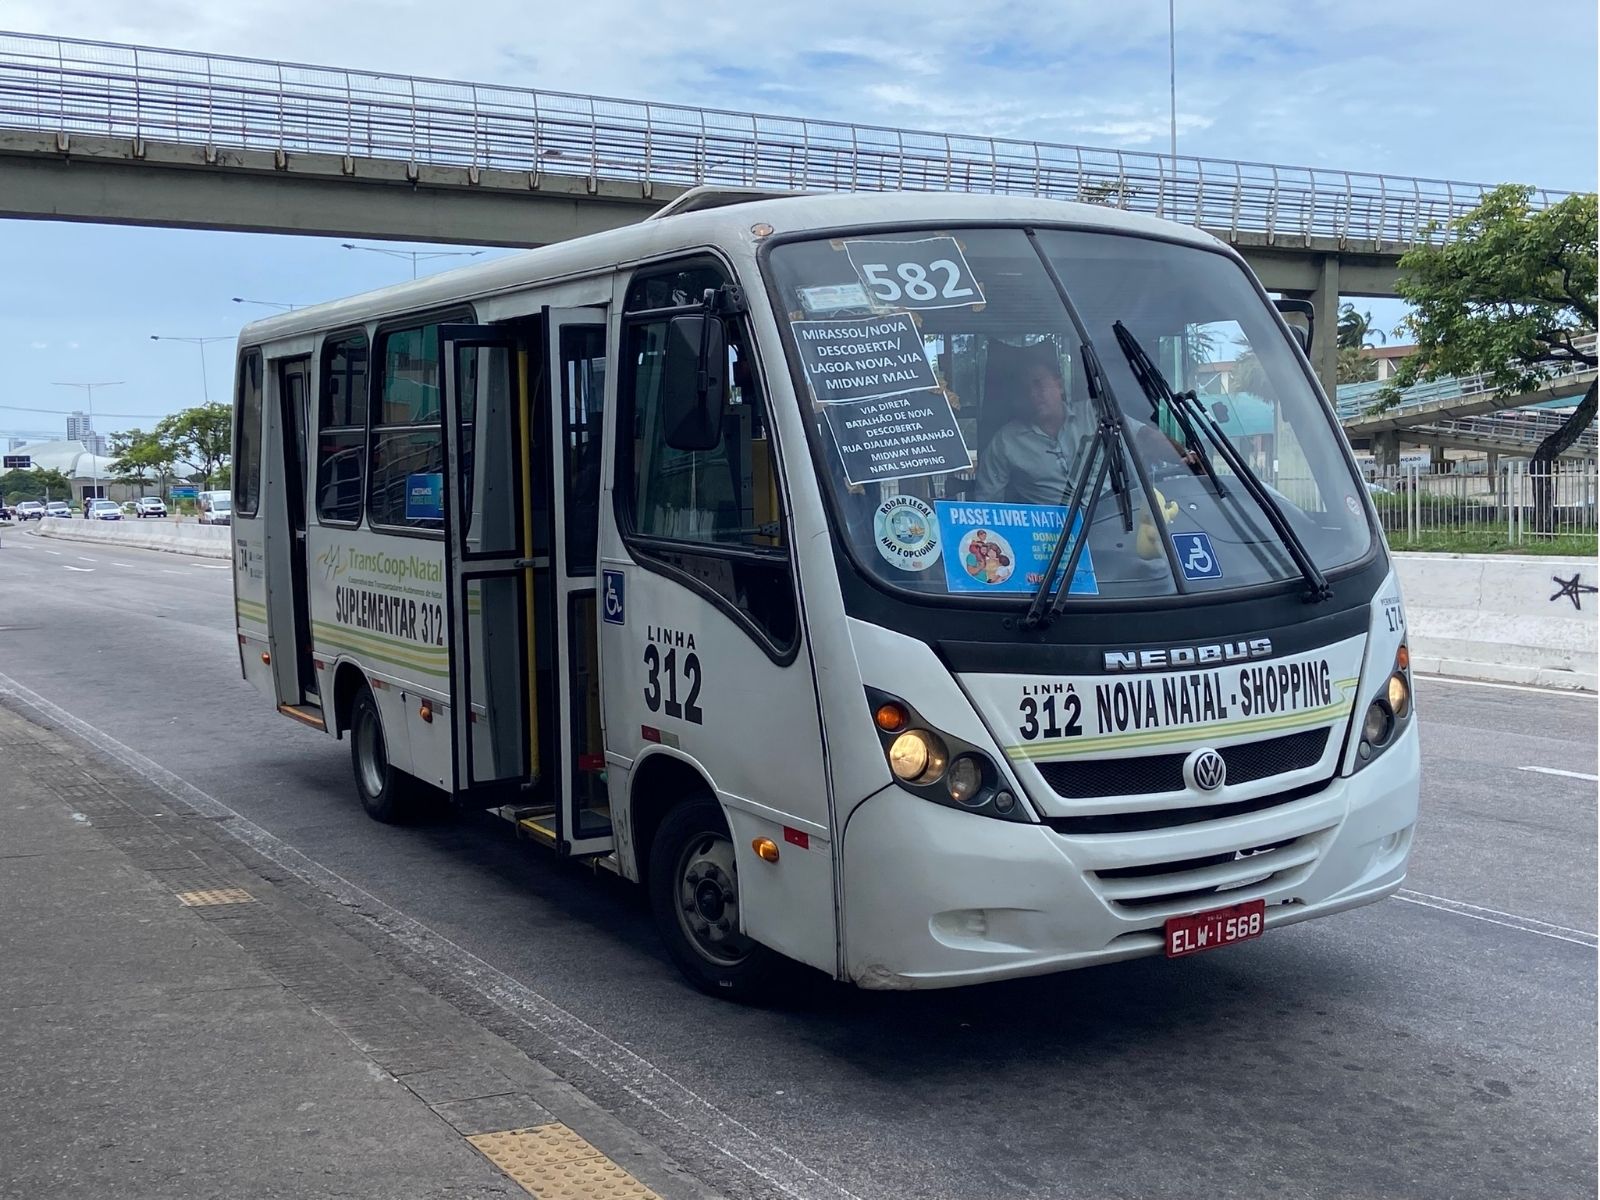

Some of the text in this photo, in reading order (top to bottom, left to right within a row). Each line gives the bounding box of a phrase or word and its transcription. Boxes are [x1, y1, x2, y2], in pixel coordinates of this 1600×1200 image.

[862, 259, 974, 301] 582
[802, 321, 908, 340] MIRASSOL/NOVA
[817, 337, 901, 357] DESCOBERTA/
[810, 352, 922, 374] LAGOA NOVA, VIA
[825, 369, 919, 390] MIDWAY MALL
[860, 398, 911, 415] VIA DIRETA
[845, 408, 934, 429] BATALHÃO DE NOVA
[866, 422, 923, 438] DESCOBERTA
[842, 429, 955, 453] RUA DJALMA MARANHÃO
[870, 444, 936, 462] MIDWAY MALL
[869, 456, 946, 474] NATAL SHOPPING
[880, 497, 931, 517] RODAR LEGAL
[950, 507, 991, 526] PASSE
[992, 509, 1030, 527] LIVRE
[903, 539, 937, 558] OPCIONAL
[348, 548, 443, 583] TransCoop-Natal
[335, 585, 443, 646] SUPLEMENTAR 312
[647, 625, 697, 650] LINHA
[1104, 638, 1273, 671] NEOBUS
[643, 643, 703, 726] 312
[1022, 682, 1076, 696] LINHA
[1095, 679, 1160, 734] NOVA
[1161, 672, 1228, 726] NATAL
[1239, 659, 1332, 716] SHOPPING
[1019, 694, 1083, 740] 312
